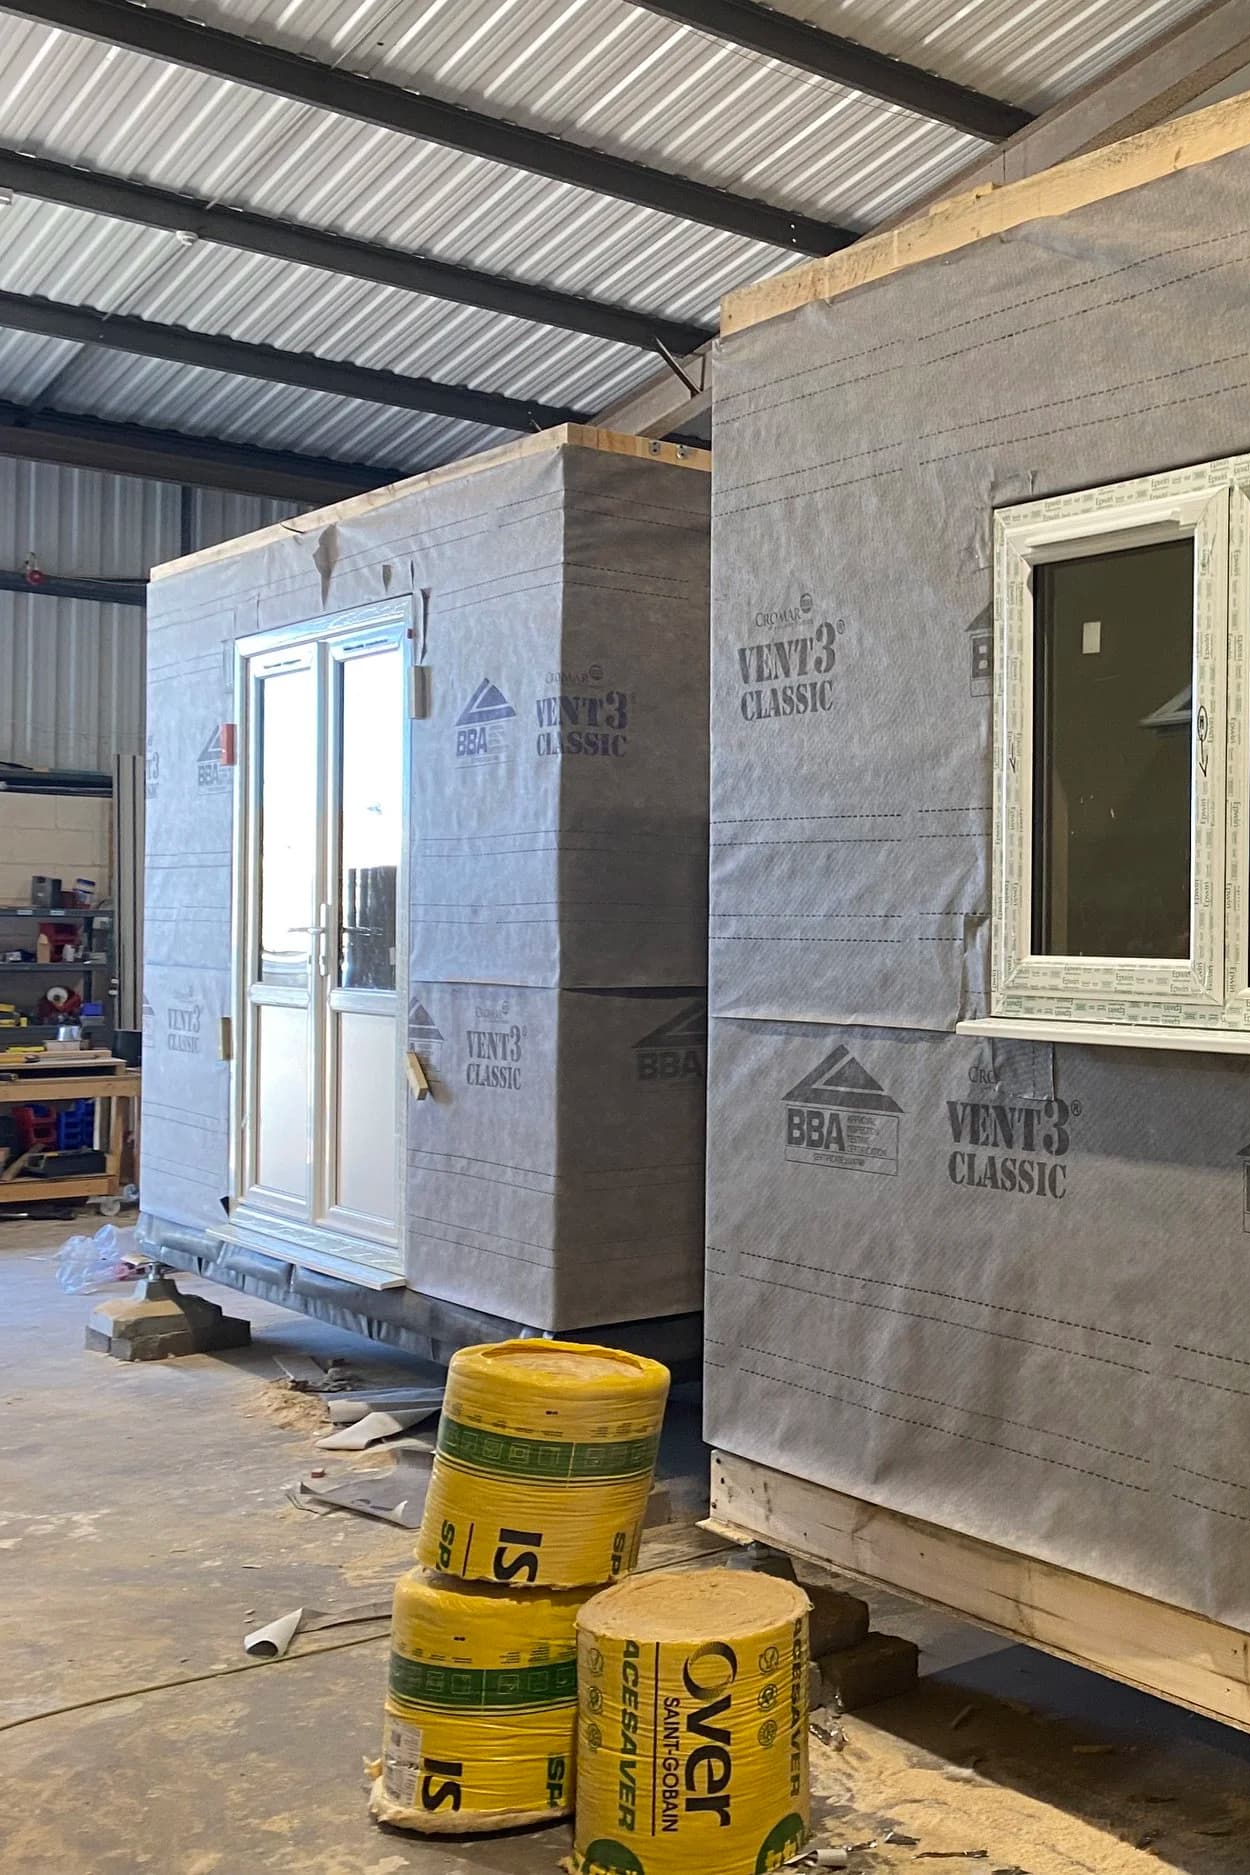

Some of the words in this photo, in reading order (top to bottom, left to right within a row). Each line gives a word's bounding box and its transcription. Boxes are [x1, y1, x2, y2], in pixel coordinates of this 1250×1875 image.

[740, 679, 833, 722] CLASSIC
[456, 726, 488, 757] BBA
[537, 731, 627, 757] CLASSIC
[1232, 801, 1241, 828] Epwin
[466, 1063, 522, 1090] CLASSIC
[787, 1108, 846, 1152] BBA
[948, 1150, 1068, 1200] CLASSIC
[436, 1519, 456, 1572] SP
[618, 1639, 640, 1832] ACESAVER
[661, 1696, 681, 1833] SAINT-GOBAIN
